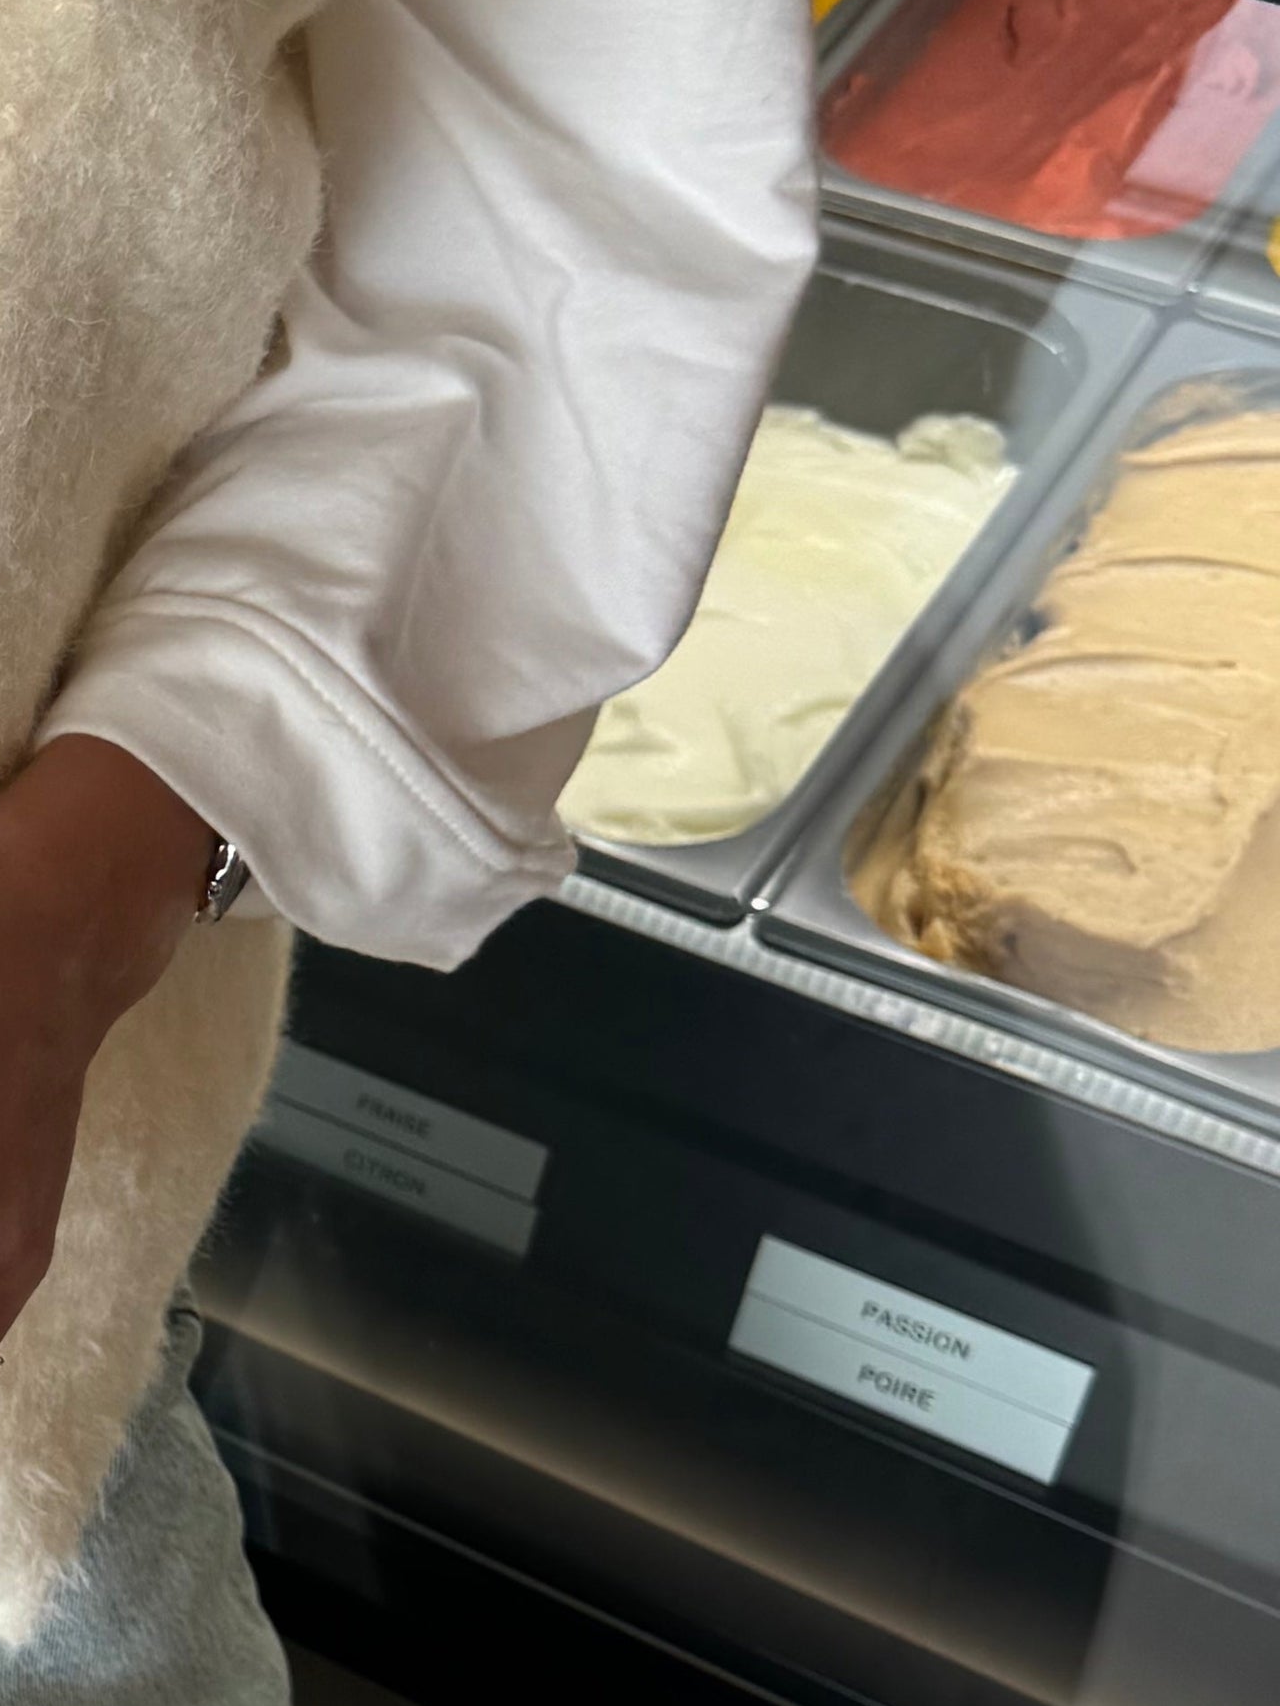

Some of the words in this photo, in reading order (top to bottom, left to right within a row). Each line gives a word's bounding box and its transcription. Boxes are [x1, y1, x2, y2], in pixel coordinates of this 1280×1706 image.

[354, 1091, 432, 1138] FRAISE
[343, 1146, 428, 1197] CITRON
[860, 1299, 971, 1360] PASSION
[857, 1363, 935, 1412] POIRE
